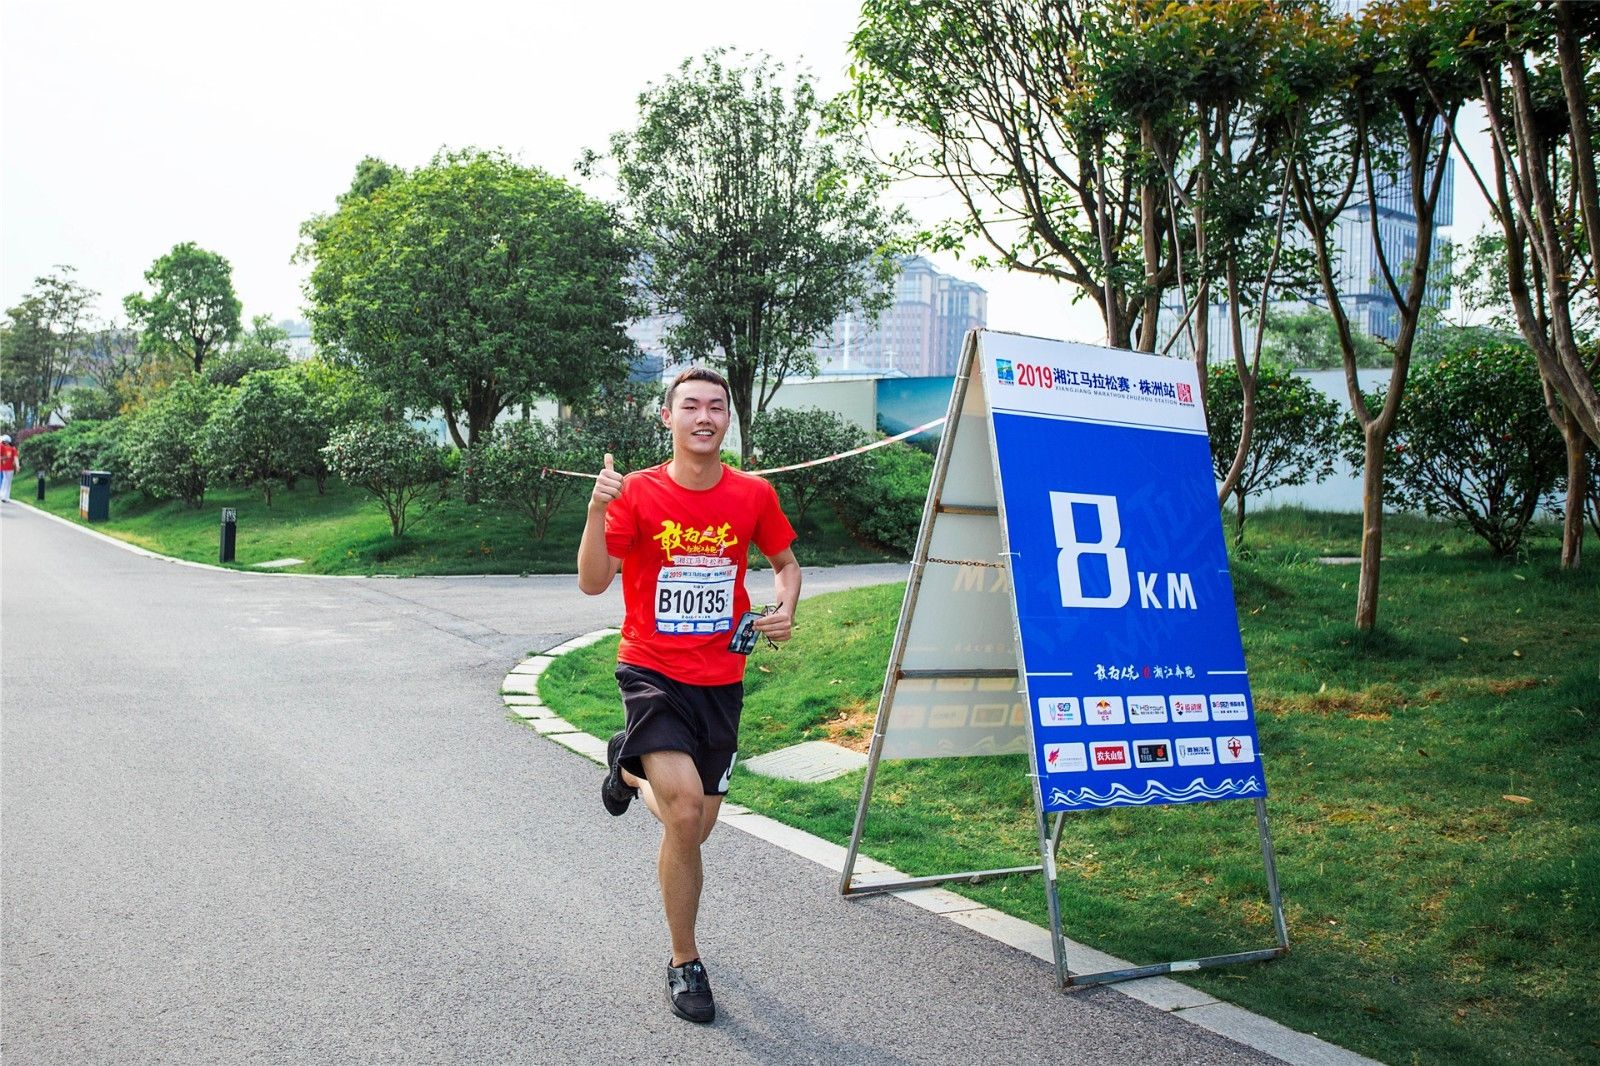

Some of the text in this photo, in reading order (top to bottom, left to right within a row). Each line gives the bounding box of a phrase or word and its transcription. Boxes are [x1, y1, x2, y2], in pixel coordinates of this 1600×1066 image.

[1016, 363, 1053, 389] 2019
[1093, 390, 1126, 399] MARATHON
[1154, 397, 1178, 405] STATION
[1049, 491, 1131, 609] 8
[1137, 571, 1198, 609] KM
[658, 588, 726, 614] B10135
[1096, 750, 1124, 761] 农夫山泉
